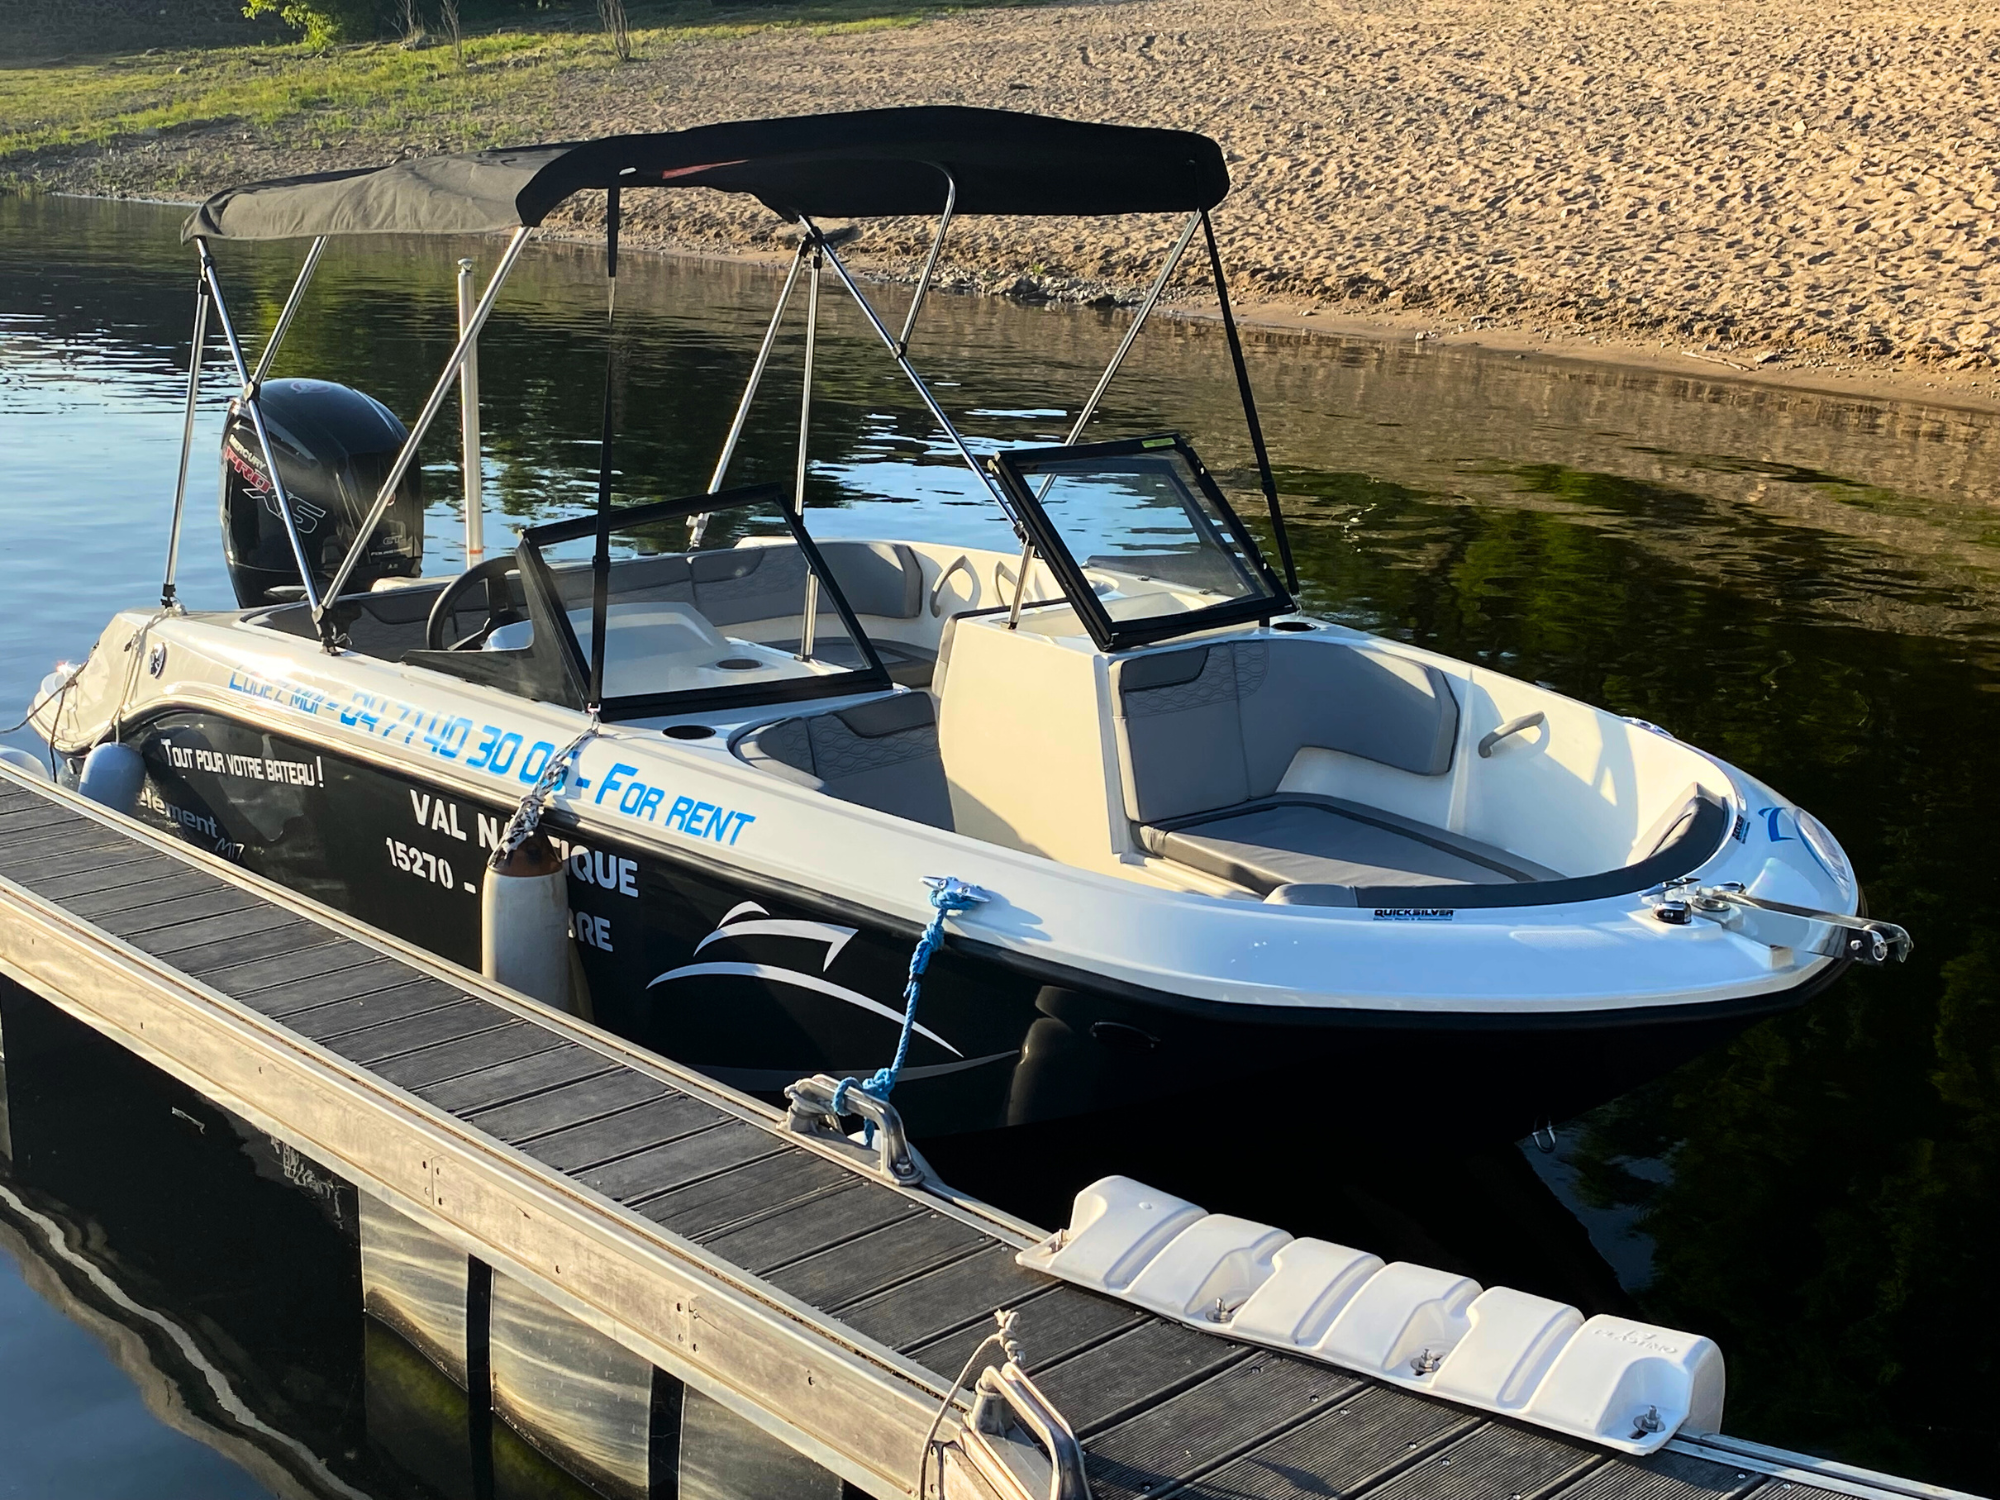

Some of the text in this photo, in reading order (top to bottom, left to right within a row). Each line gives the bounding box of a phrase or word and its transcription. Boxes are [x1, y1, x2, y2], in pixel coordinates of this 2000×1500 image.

[225, 445, 271, 493] PRO
[229, 434, 266, 470] MERCURY
[195, 749, 226, 774] POUR
[225, 754, 264, 780] VOTRE
[265, 759, 316, 787] BATEAU
[340, 691, 388, 732] 04
[382, 704, 425, 744] 71
[424, 710, 473, 758] 40
[466, 725, 524, 775] 30
[595, 763, 665, 822] FOR
[665, 795, 756, 846] RENT
[409, 789, 467, 841] VAL
[385, 837, 454, 890] 15270
[1373, 909, 1455, 918] QUICKSILVER
